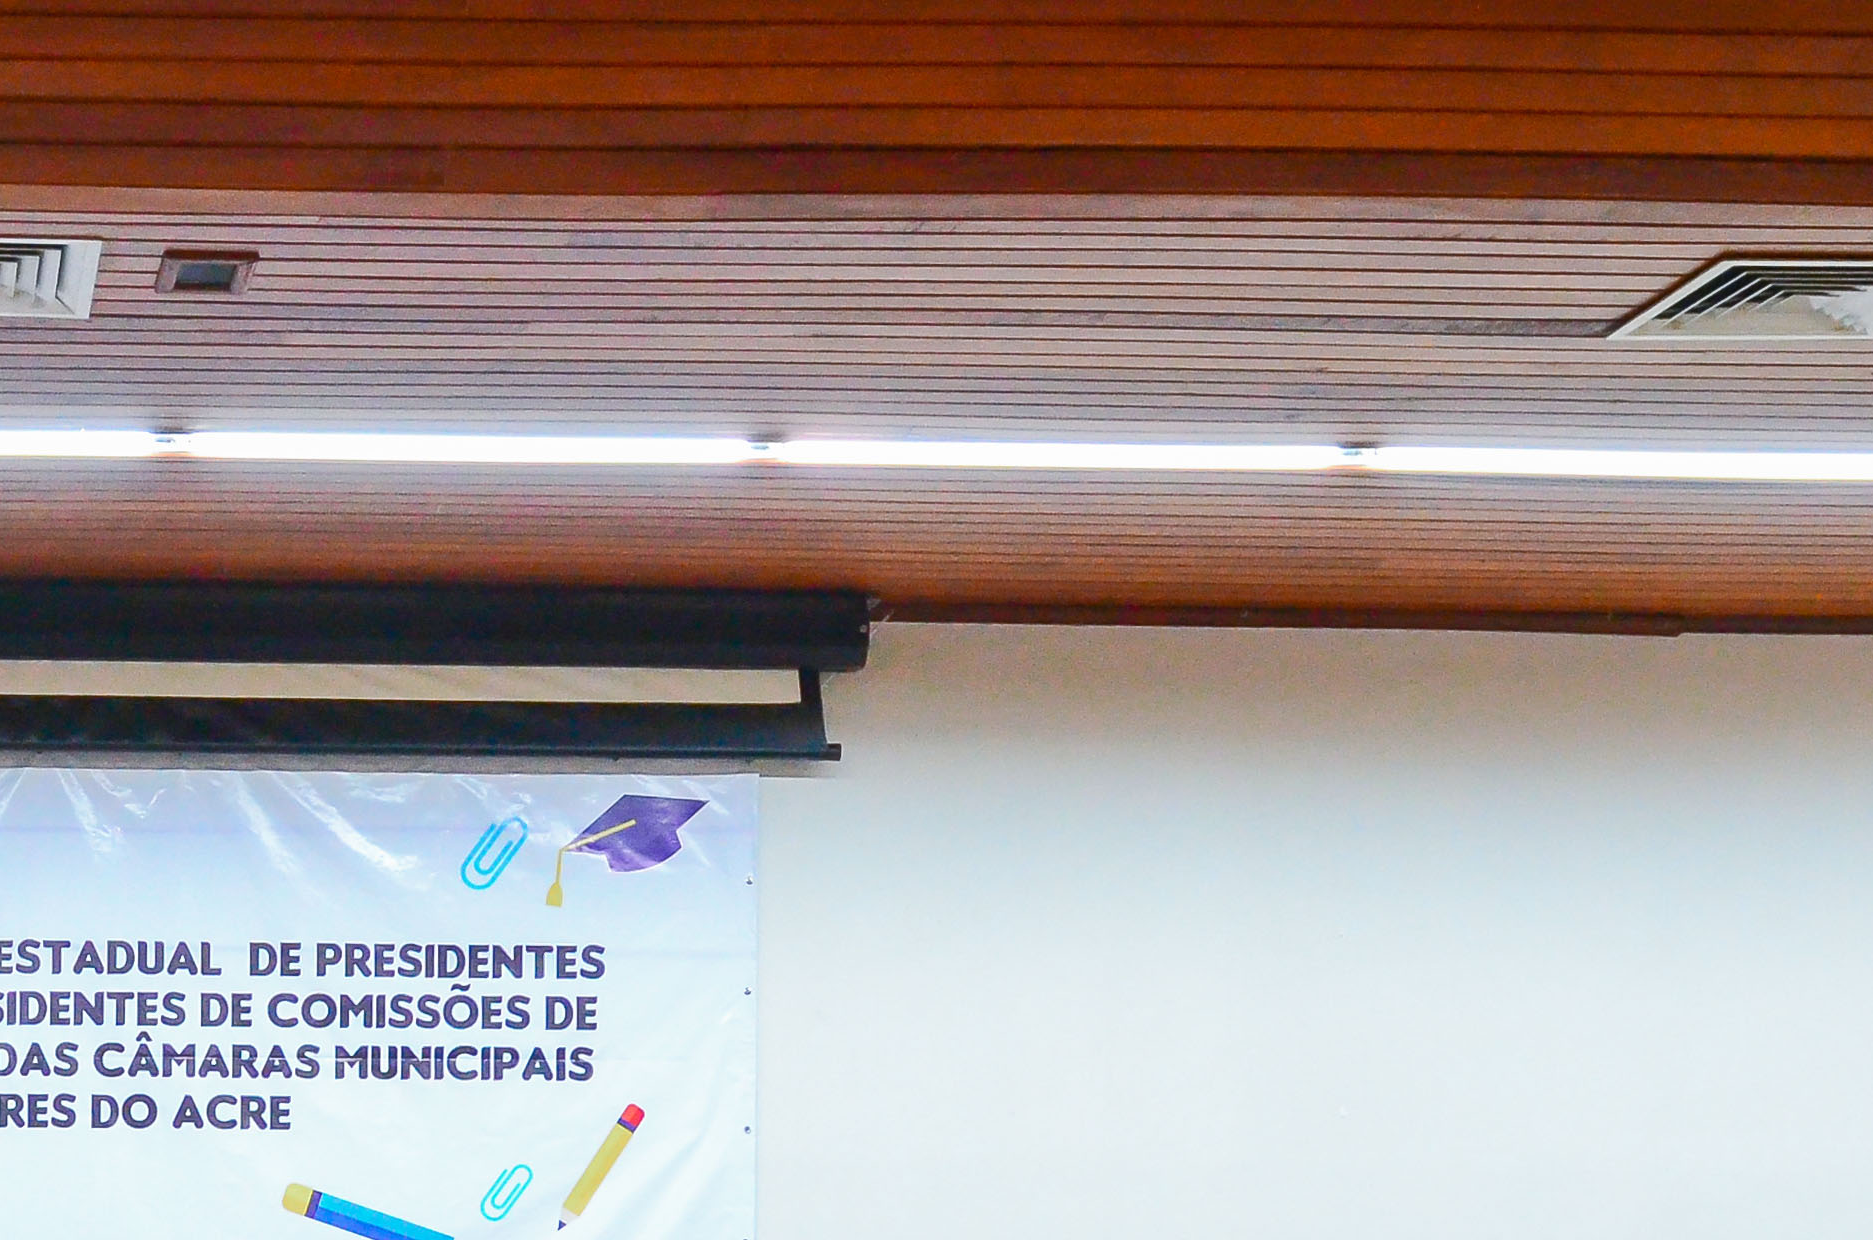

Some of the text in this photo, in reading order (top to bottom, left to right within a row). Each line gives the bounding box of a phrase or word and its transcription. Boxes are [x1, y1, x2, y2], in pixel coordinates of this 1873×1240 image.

[249, 942, 302, 977] DE
[316, 943, 605, 979] PRESIDENTES
[200, 992, 252, 1028] DE
[267, 982, 531, 1030] COMISSÕES
[545, 995, 598, 1031] DE
[93, 1032, 320, 1079] CÂMARAS
[334, 1045, 594, 1081] MUNICIPAIS
[91, 1094, 158, 1129] DO
[172, 1095, 291, 1130] ACRE
